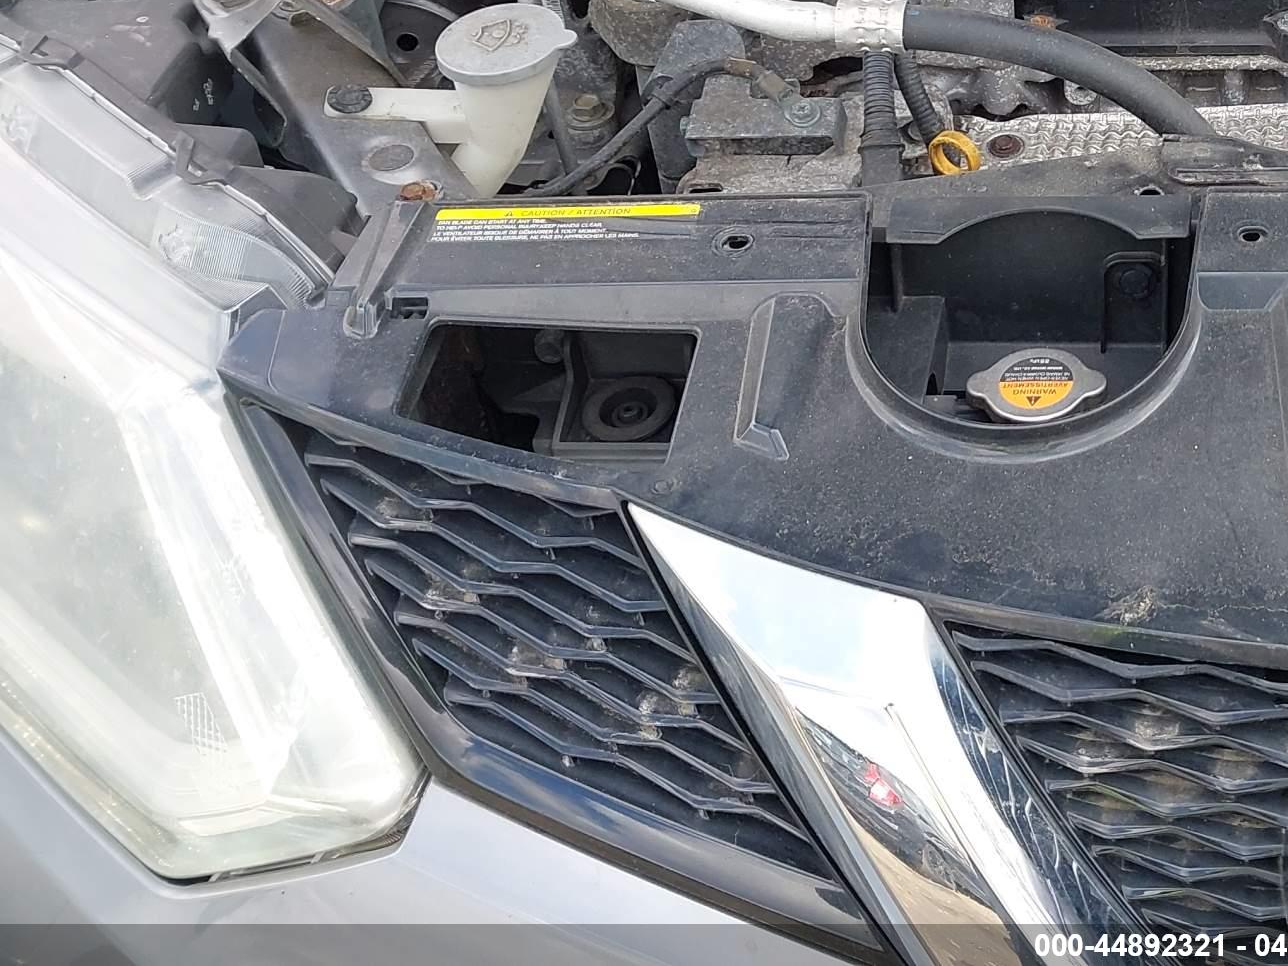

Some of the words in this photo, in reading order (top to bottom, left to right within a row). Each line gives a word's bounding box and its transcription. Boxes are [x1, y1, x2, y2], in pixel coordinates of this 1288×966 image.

[520, 209, 566, 218] CAUTION
[576, 207, 632, 216] ATTENTION
[1013, 388, 1057, 396] WARNING
